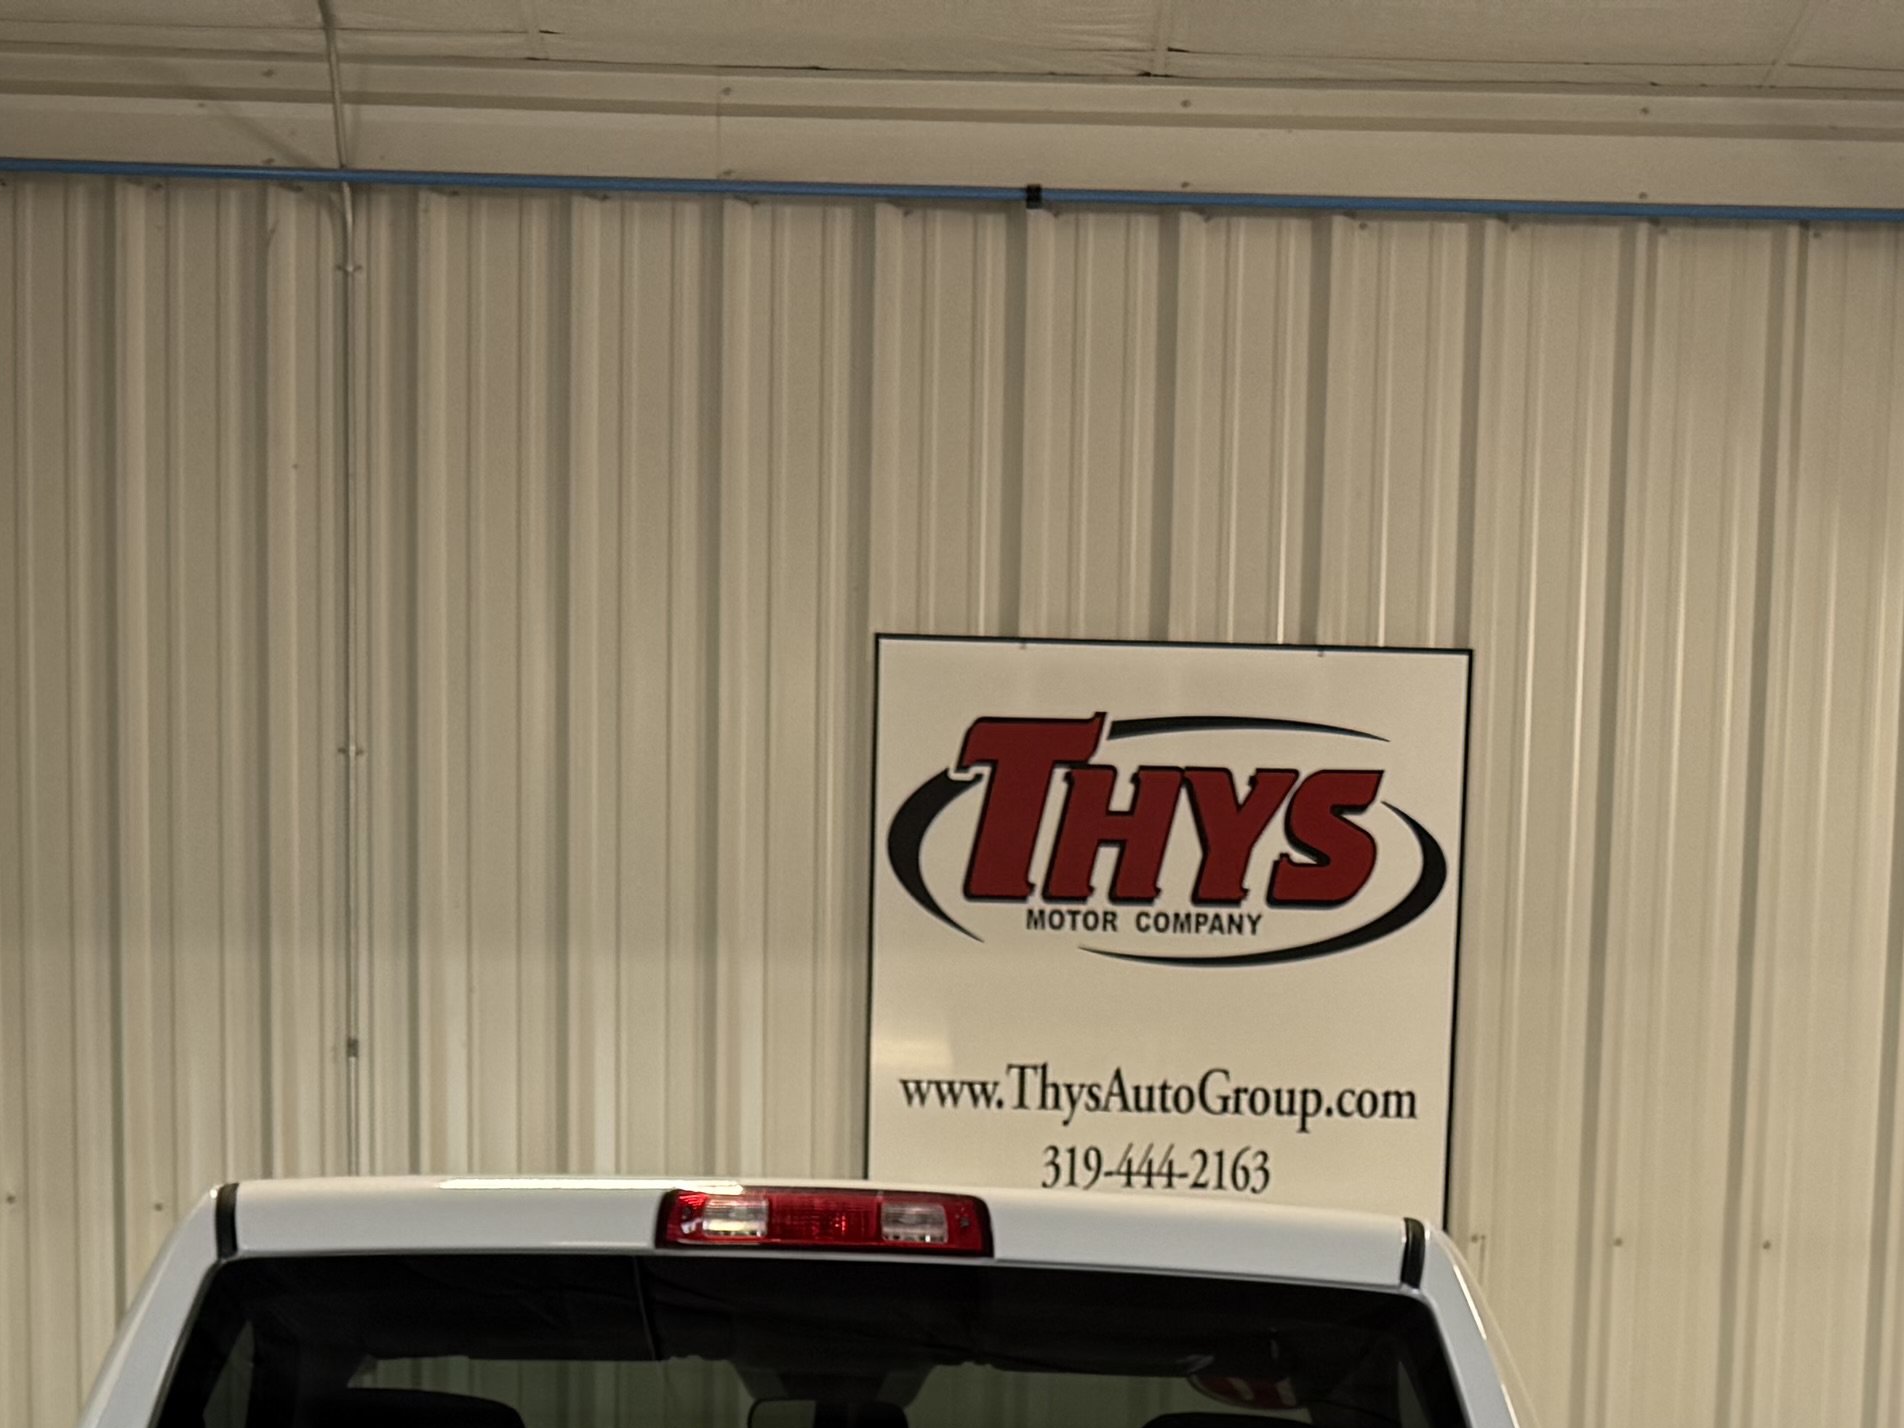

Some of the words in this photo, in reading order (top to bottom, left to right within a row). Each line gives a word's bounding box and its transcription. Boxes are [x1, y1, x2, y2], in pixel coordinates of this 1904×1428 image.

[955, 711, 1385, 910] THYS
[1026, 908, 1118, 933] MOTOR
[1135, 911, 1263, 936] COMPANY
[898, 1061, 1418, 1133] www.ThysAutoGroup.com
[1041, 1142, 1270, 1195] 319-444-2163
